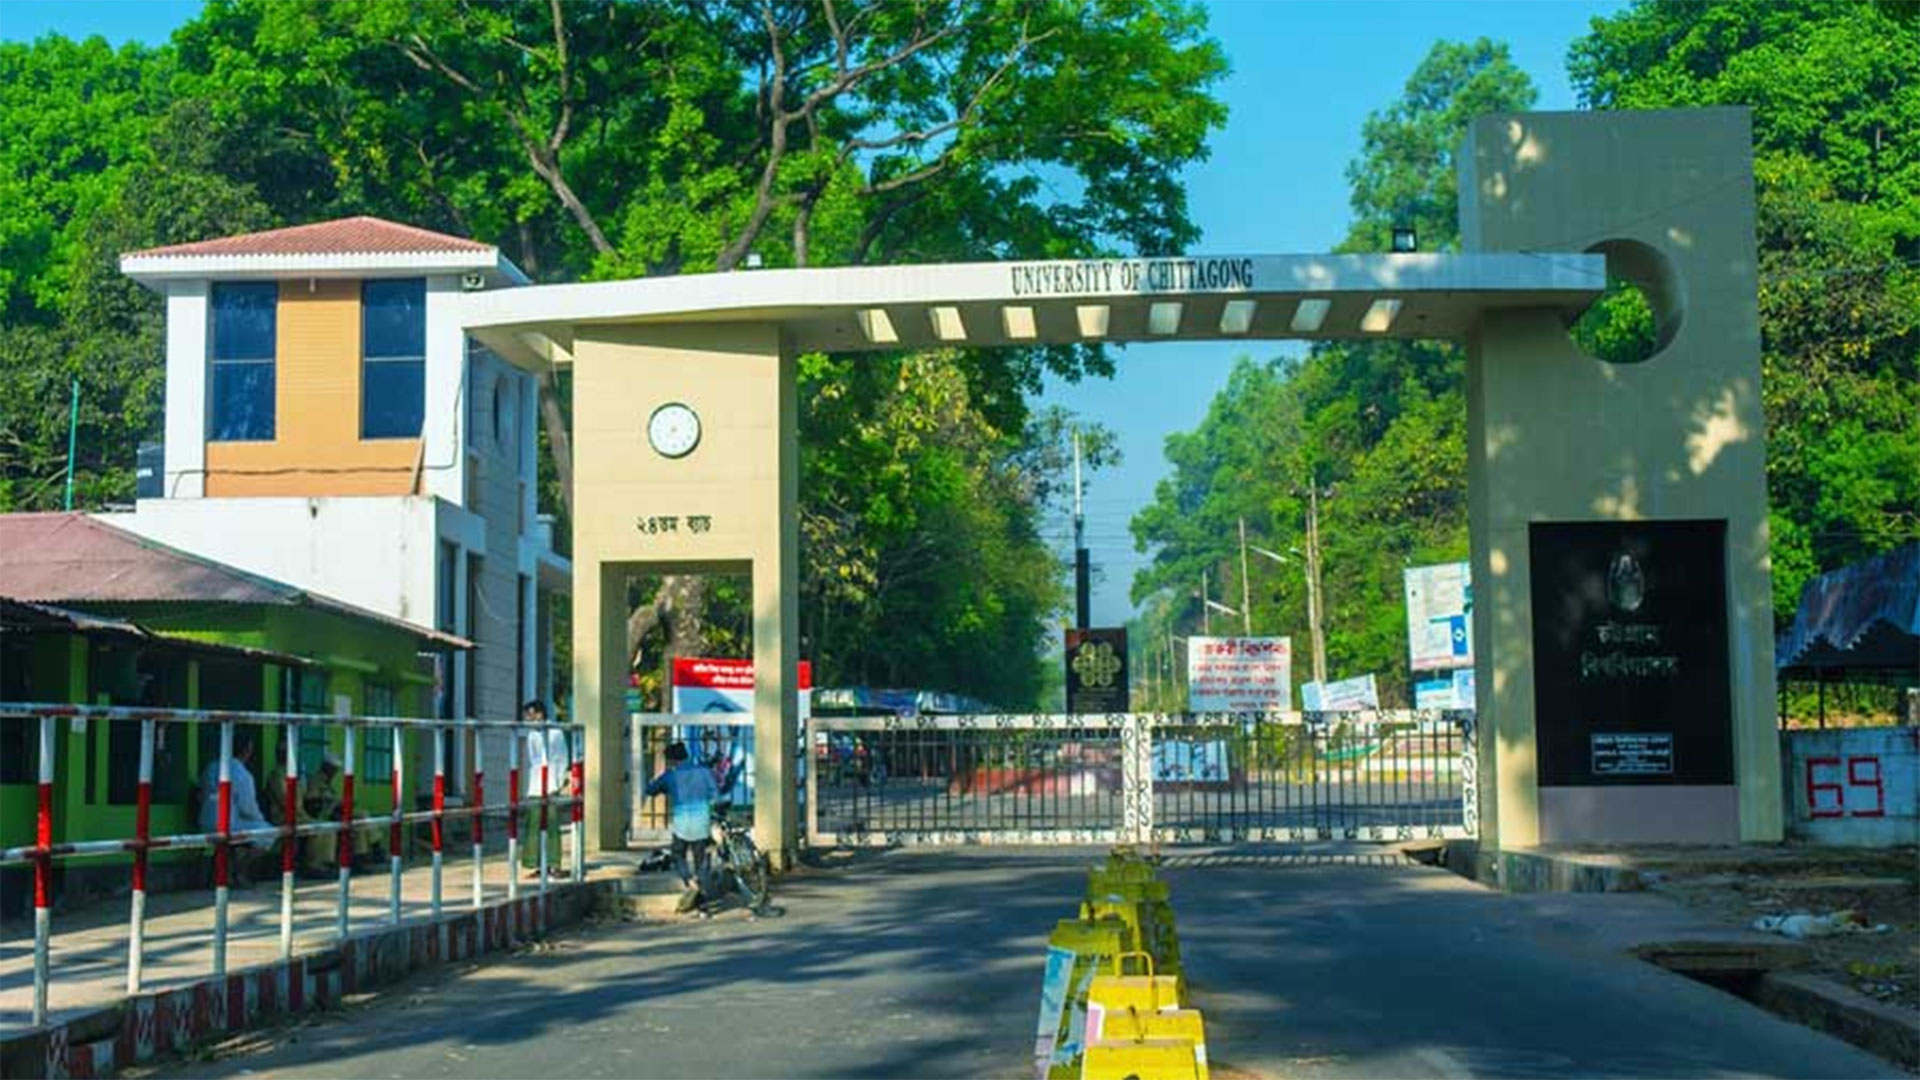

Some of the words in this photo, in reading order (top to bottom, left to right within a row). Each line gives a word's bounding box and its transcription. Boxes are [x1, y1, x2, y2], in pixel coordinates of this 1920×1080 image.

[1011, 262, 1113, 295] UNIVERSITY
[1120, 261, 1141, 292] OF
[1148, 258, 1253, 290] CHITTAGONG
[1806, 757, 1884, 818] 69
